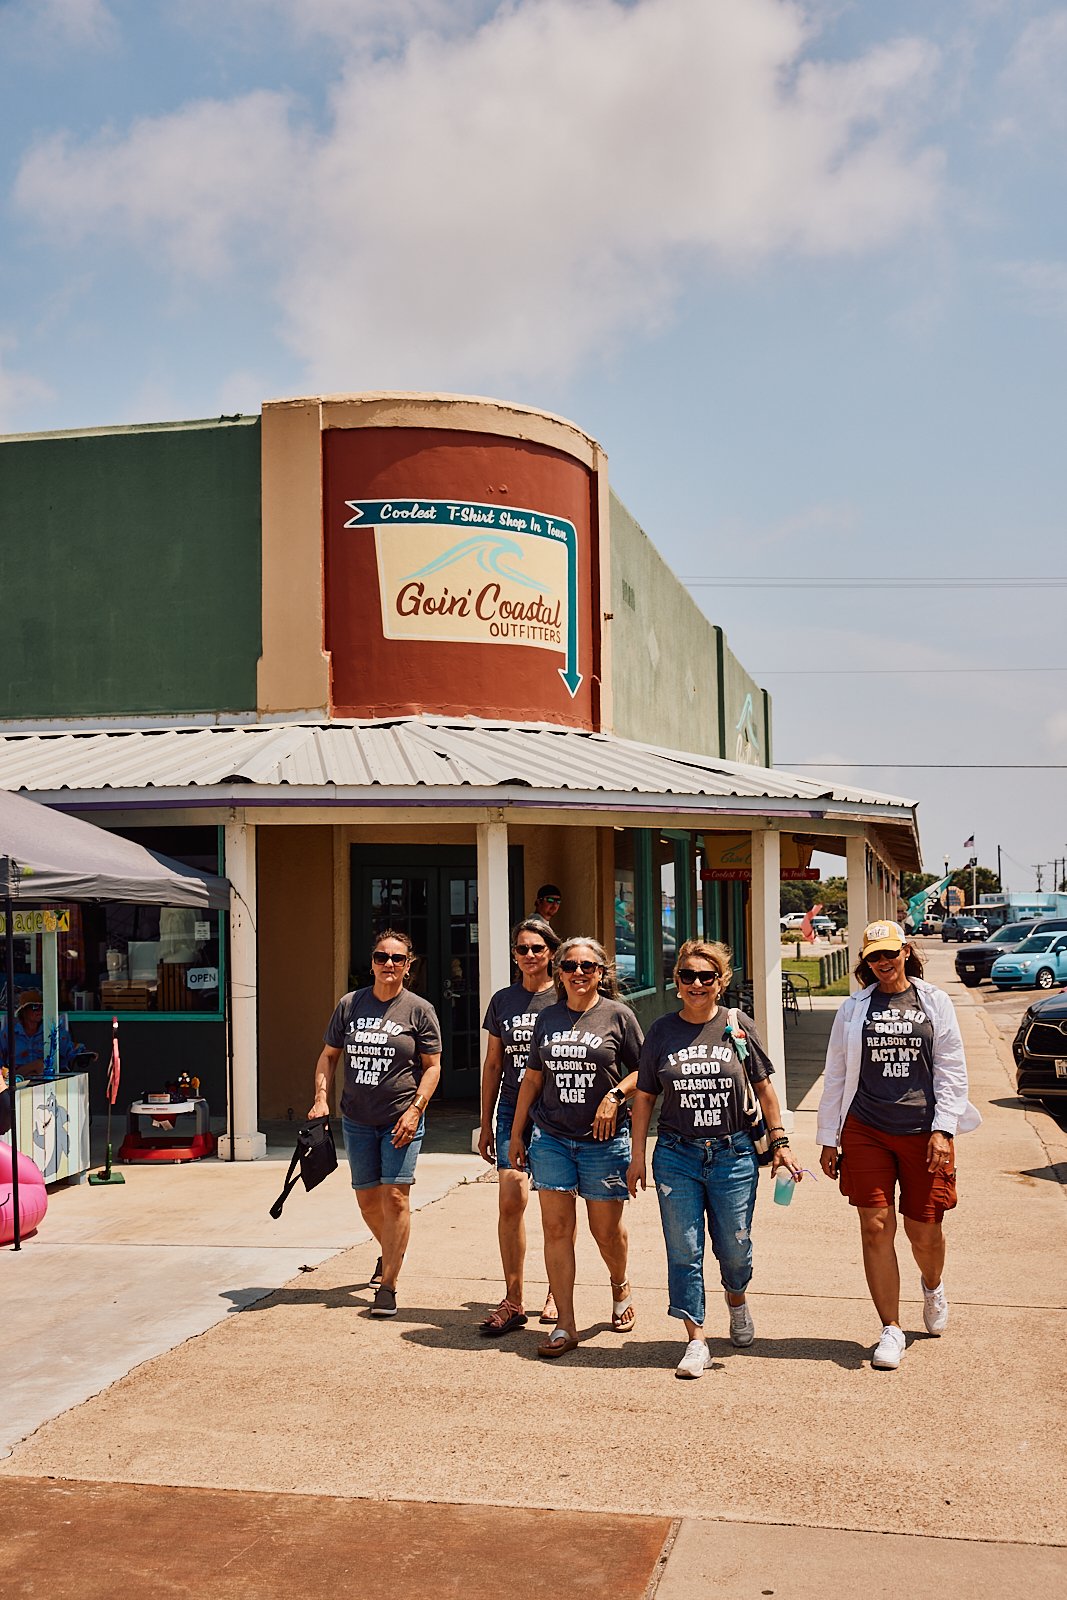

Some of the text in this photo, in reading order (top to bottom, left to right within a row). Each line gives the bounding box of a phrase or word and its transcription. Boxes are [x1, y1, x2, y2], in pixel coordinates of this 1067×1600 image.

[380, 503, 567, 541] Coolest T-Shirt Shop In Town
[396, 582, 561, 628] Goin' Coastal
[490, 622, 561, 643] OUTFITTERS
[189, 973, 216, 983] OPEN
[871, 1009, 926, 1024] SEE NO
[350, 1017, 403, 1036] I SEE NO
[503, 1020, 510, 1031] I
[874, 1022, 913, 1035] GOOD
[355, 1031, 388, 1045] GOOD
[552, 1031, 580, 1043] SEE
[580, 1032, 603, 1049] NO
[866, 1036, 922, 1048] REASON TO
[347, 1045, 396, 1057] REASON TO
[551, 1045, 587, 1059] GOOD
[667, 1045, 732, 1066] I SEE NO
[871, 1048, 920, 1063] ACT MY
[350, 1056, 392, 1071] ACT MY
[584, 1062, 597, 1071] TO
[681, 1062, 720, 1075] GOOD
[882, 1062, 910, 1077] AGE
[355, 1070, 380, 1086] AGE
[553, 1073, 597, 1088] CT MY
[672, 1078, 732, 1091] REASON TO
[560, 1088, 586, 1103] AGE
[680, 1092, 730, 1109] ACT MY
[693, 1109, 722, 1127] AGE
